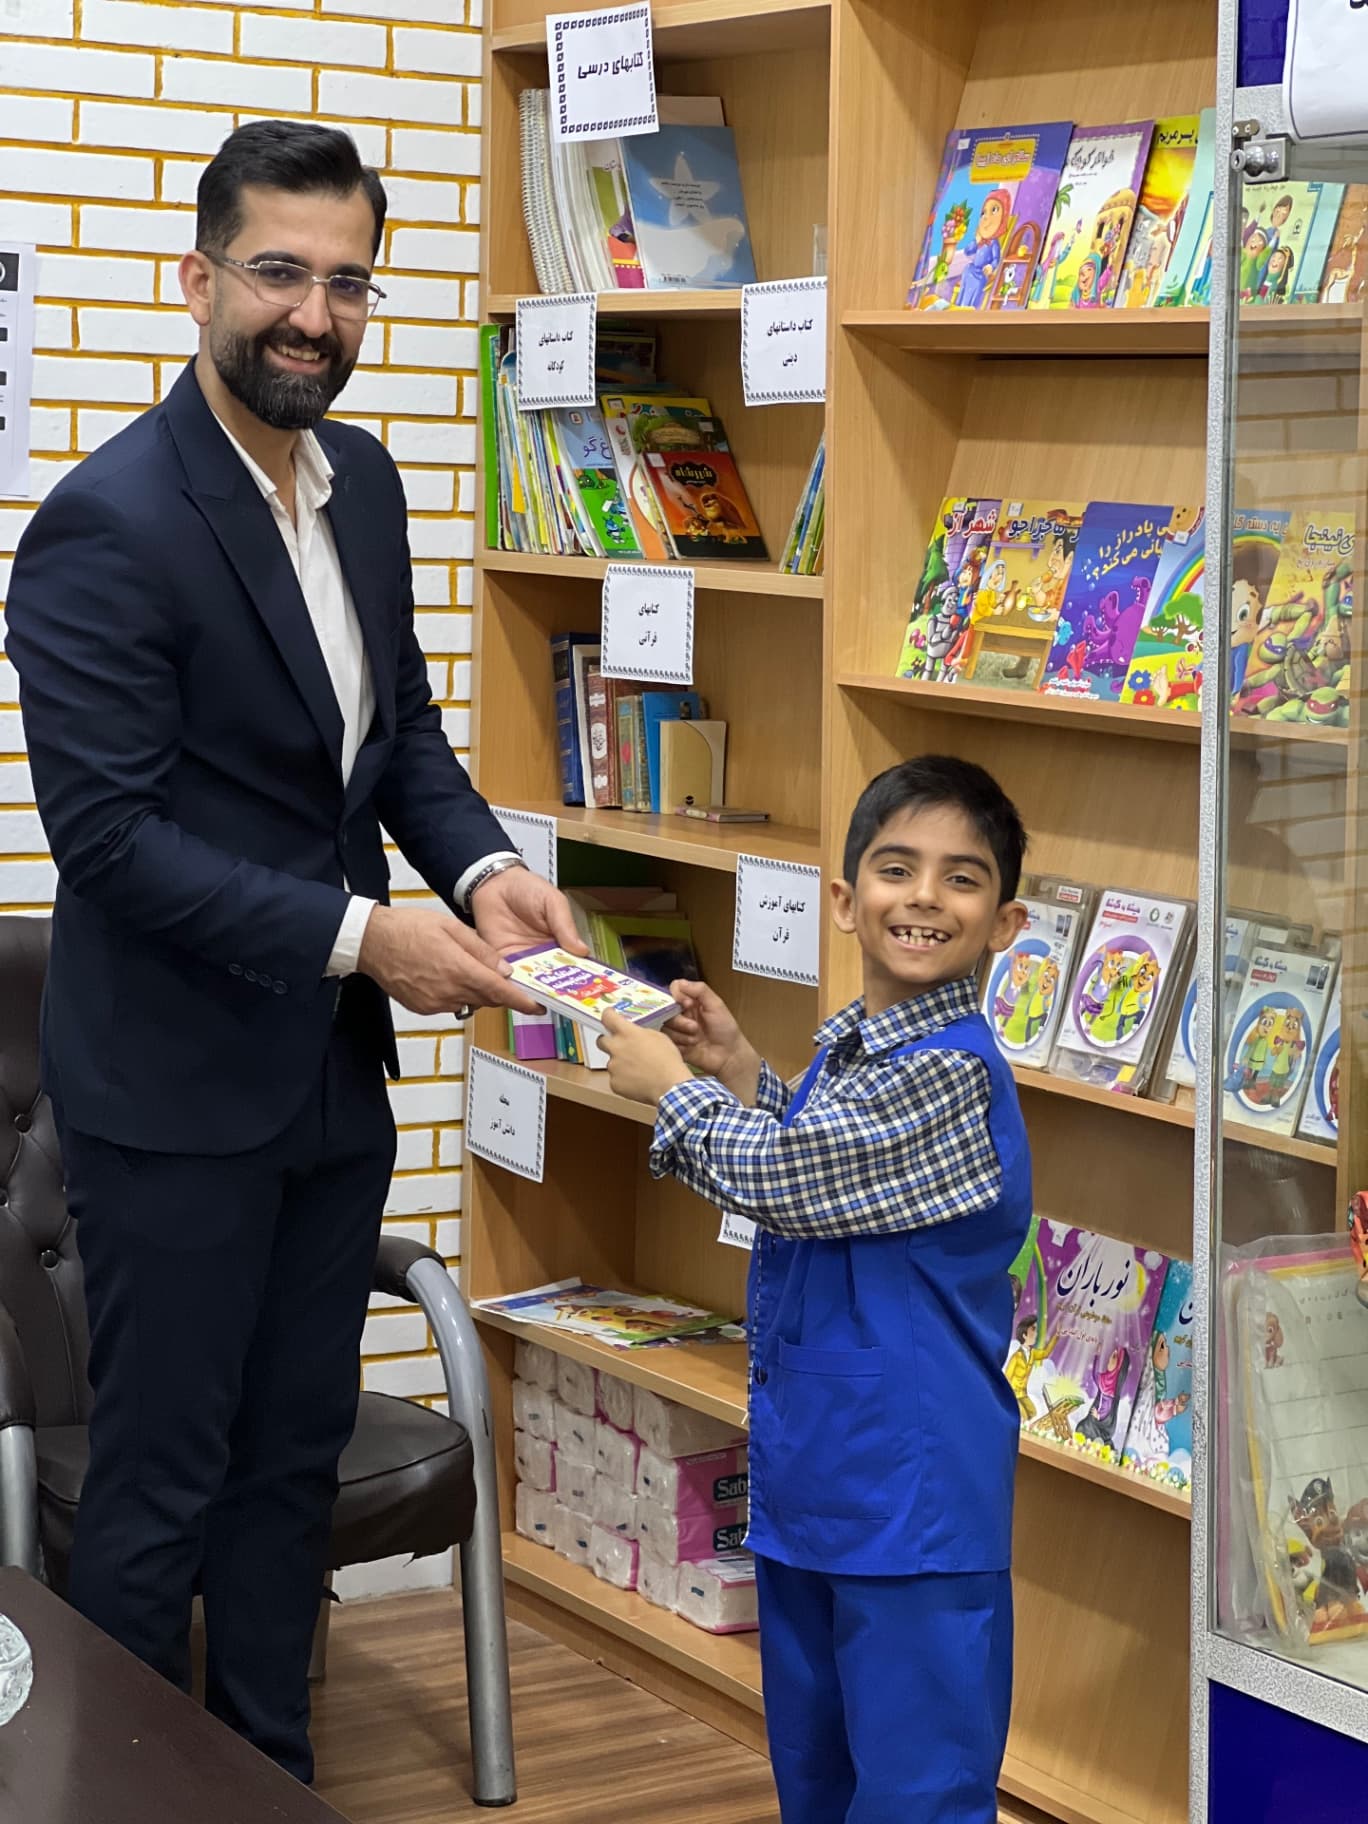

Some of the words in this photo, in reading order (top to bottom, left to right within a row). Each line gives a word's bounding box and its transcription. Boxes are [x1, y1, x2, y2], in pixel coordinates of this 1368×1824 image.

[578, 61, 609, 79] درسی
[612, 51, 643, 75] کتابهای
[767, 320, 797, 336] داستانهای
[797, 318, 814, 334] کتاب
[561, 330, 574, 344] کتاب
[782, 352, 798, 367] دینی
[963, 509, 997, 538] شهر
[1099, 545, 1112, 558] را
[638, 602, 660, 616] کتابهای
[759, 894, 782, 911] آموزش
[783, 899, 806, 913] کتابهای
[772, 926, 790, 944] قرآن
[1056, 1252, 1103, 1307] باران
[1100, 1259, 1131, 1300] نور
[717, 1477, 748, 1498] Sab
